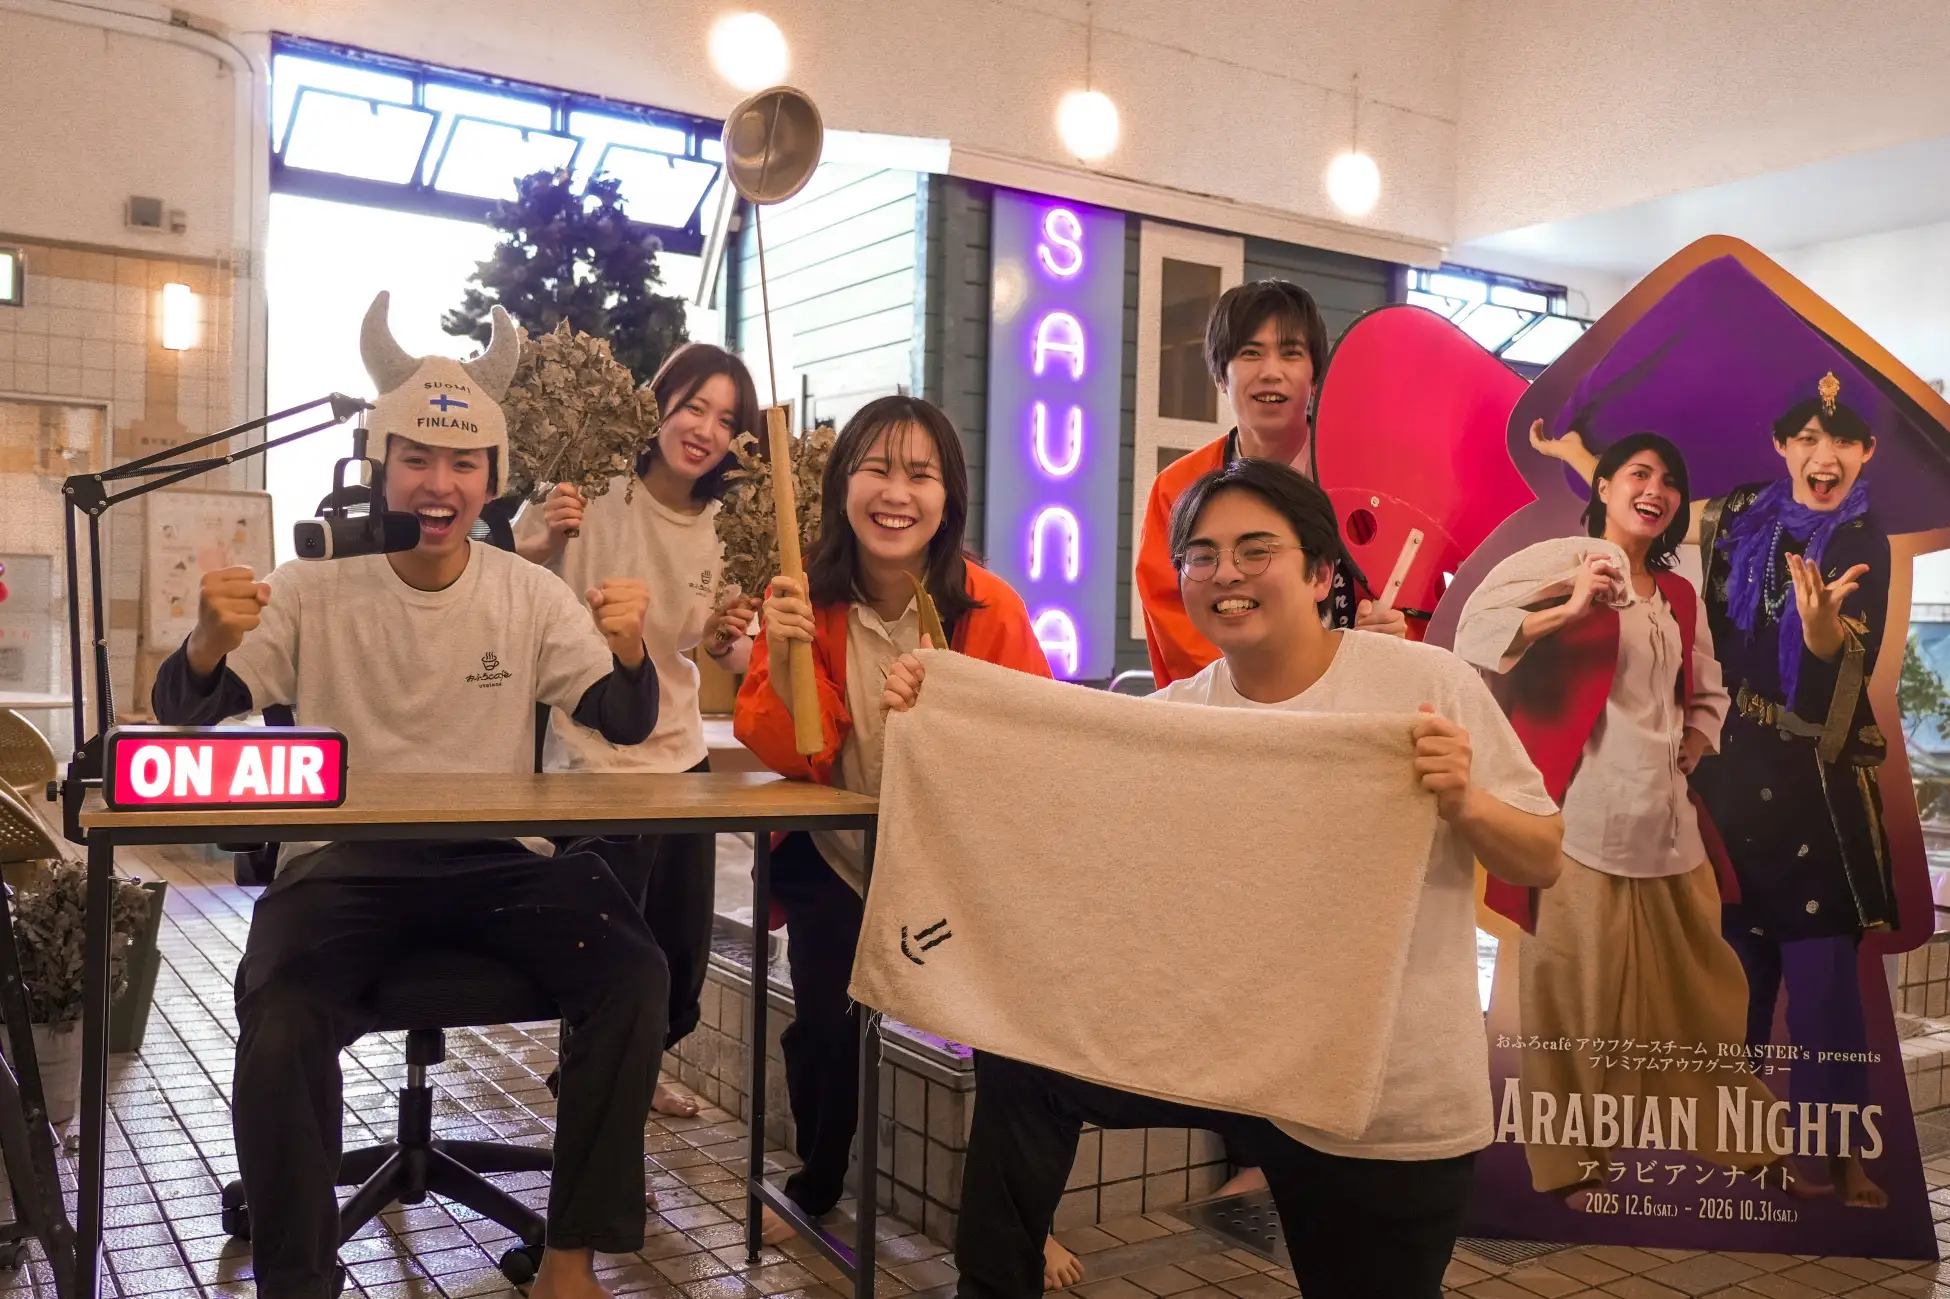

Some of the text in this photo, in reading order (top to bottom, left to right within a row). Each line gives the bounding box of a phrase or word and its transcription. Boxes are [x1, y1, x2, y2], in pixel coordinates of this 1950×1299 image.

[424, 381, 472, 394] SUOMI
[417, 417, 478, 433] FINLAND
[129, 744, 325, 798] ON AIR
[1496, 1033, 1882, 1064] おふろcafé アウフグースチーム ROASTER's presents
[1588, 1055, 1792, 1075] プレミアムアウフグースショー
[1577, 1160, 1797, 1191] アラビアンナイト
[1585, 1192, 1619, 1214] 2025
[1699, 1197, 1733, 1220] 2026
